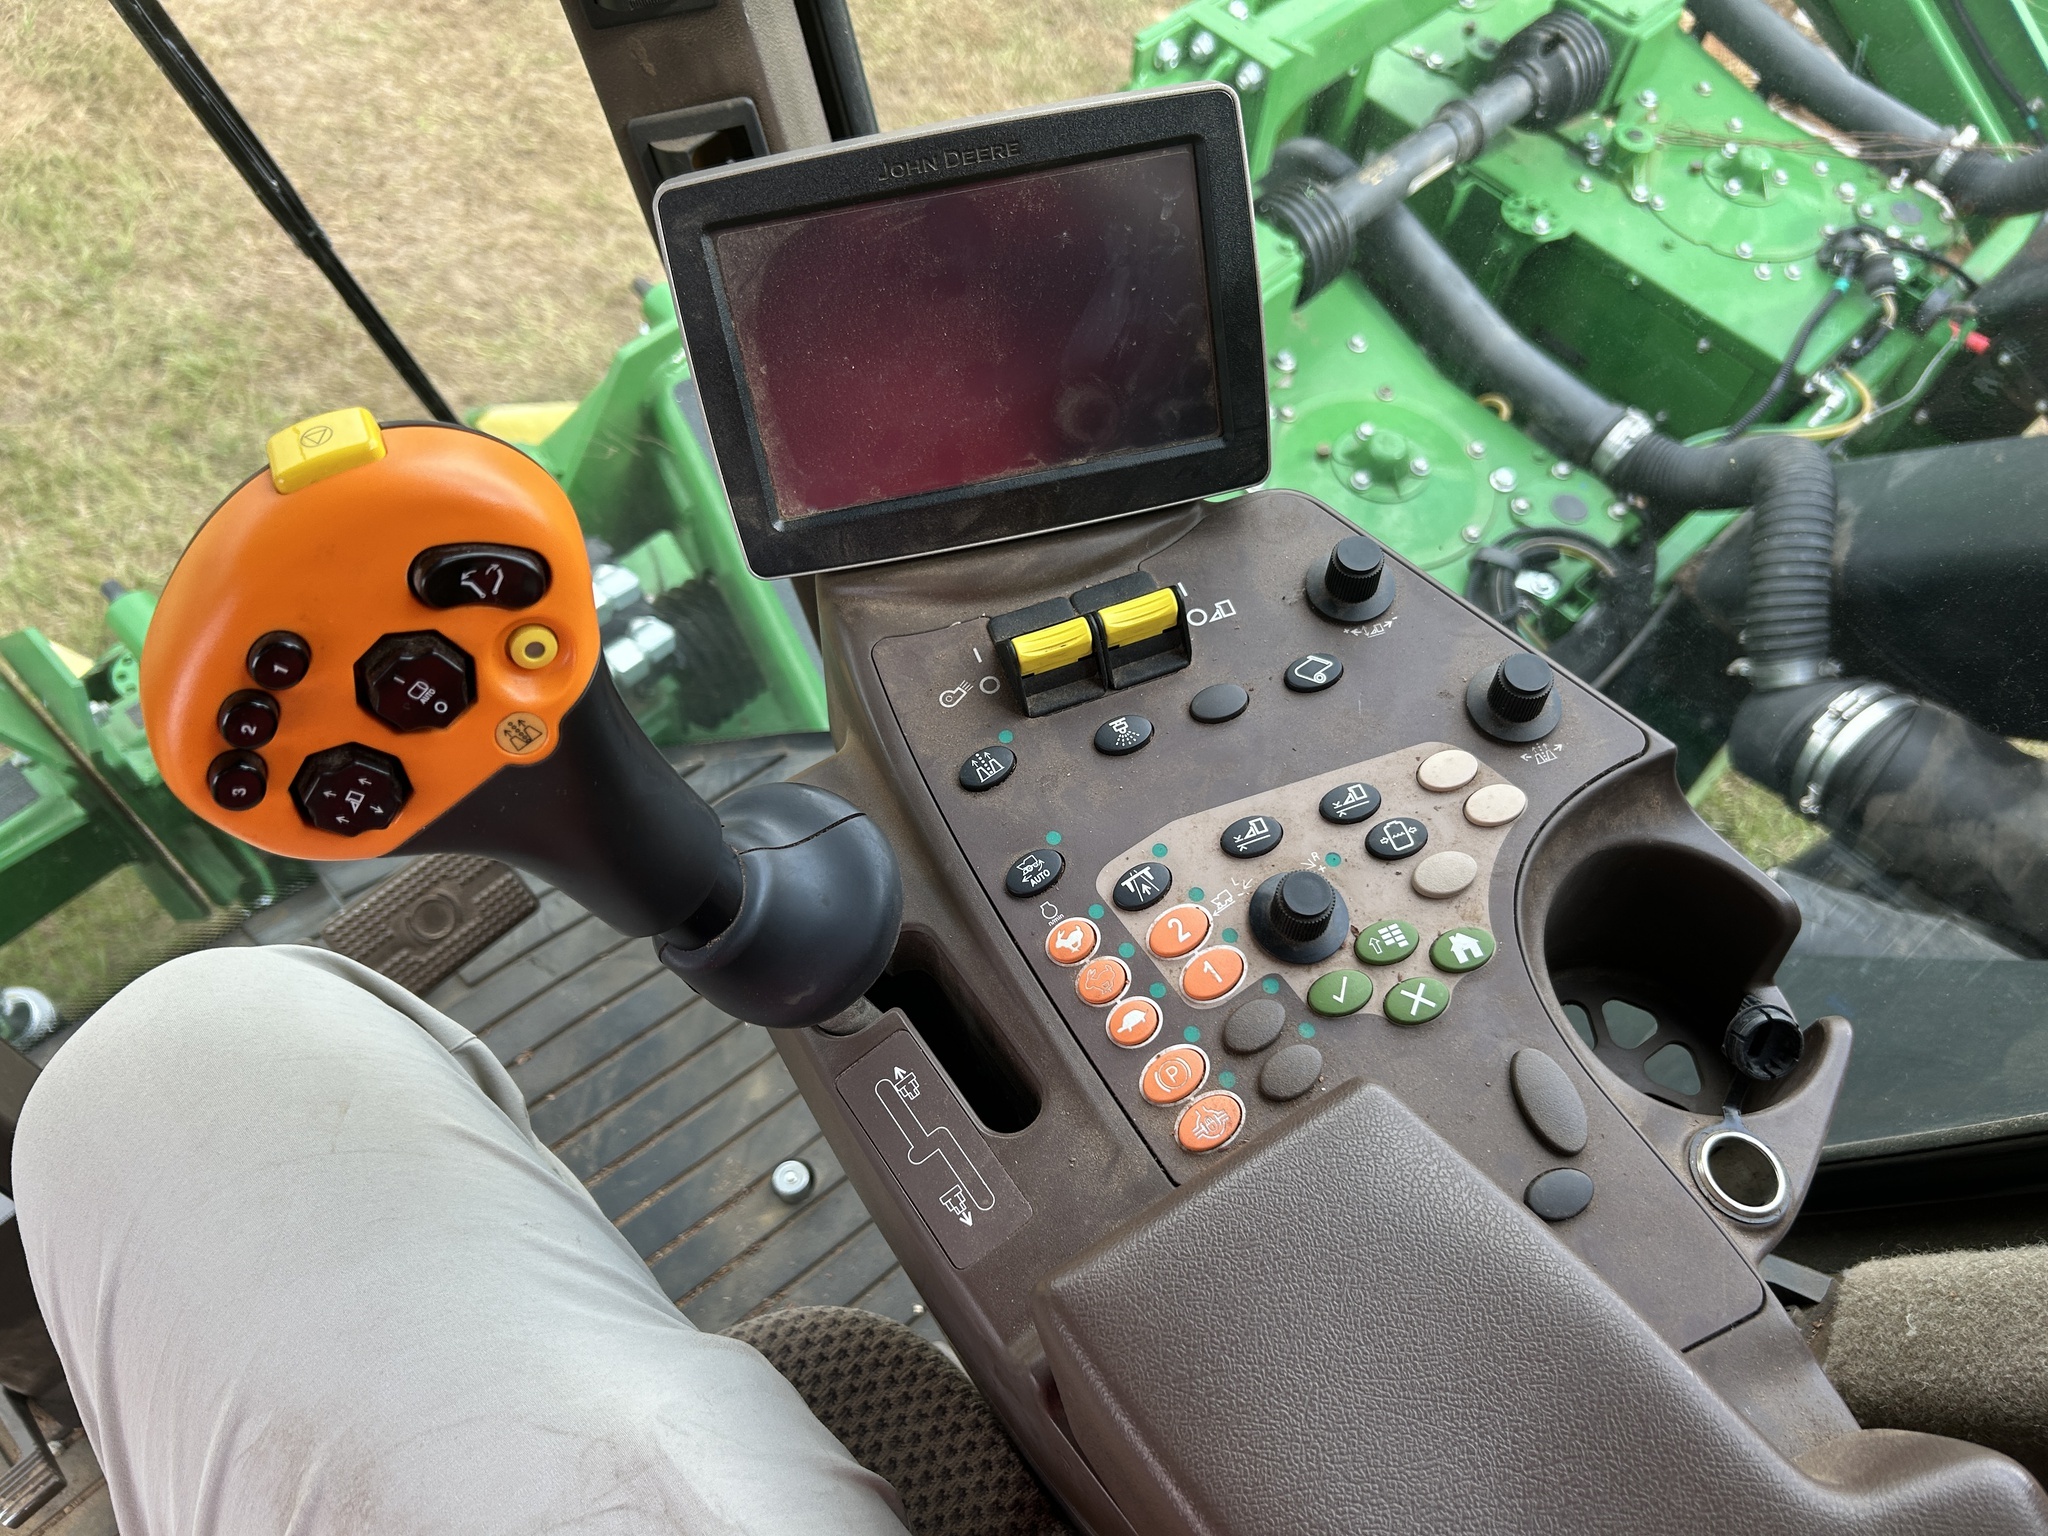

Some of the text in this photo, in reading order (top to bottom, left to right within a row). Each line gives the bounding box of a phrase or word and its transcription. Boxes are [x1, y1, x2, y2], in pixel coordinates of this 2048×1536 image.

[878, 142, 1021, 181] JOHN DEERE
[273, 664, 289, 675] 1
[420, 688, 436, 705] AUTO
[241, 724, 257, 736] 2
[232, 787, 247, 797] 3
[1030, 869, 1050, 887] AUTO
[1168, 917, 1191, 943] 2
[1203, 960, 1223, 983] 1
[1165, 1065, 1178, 1083] P
